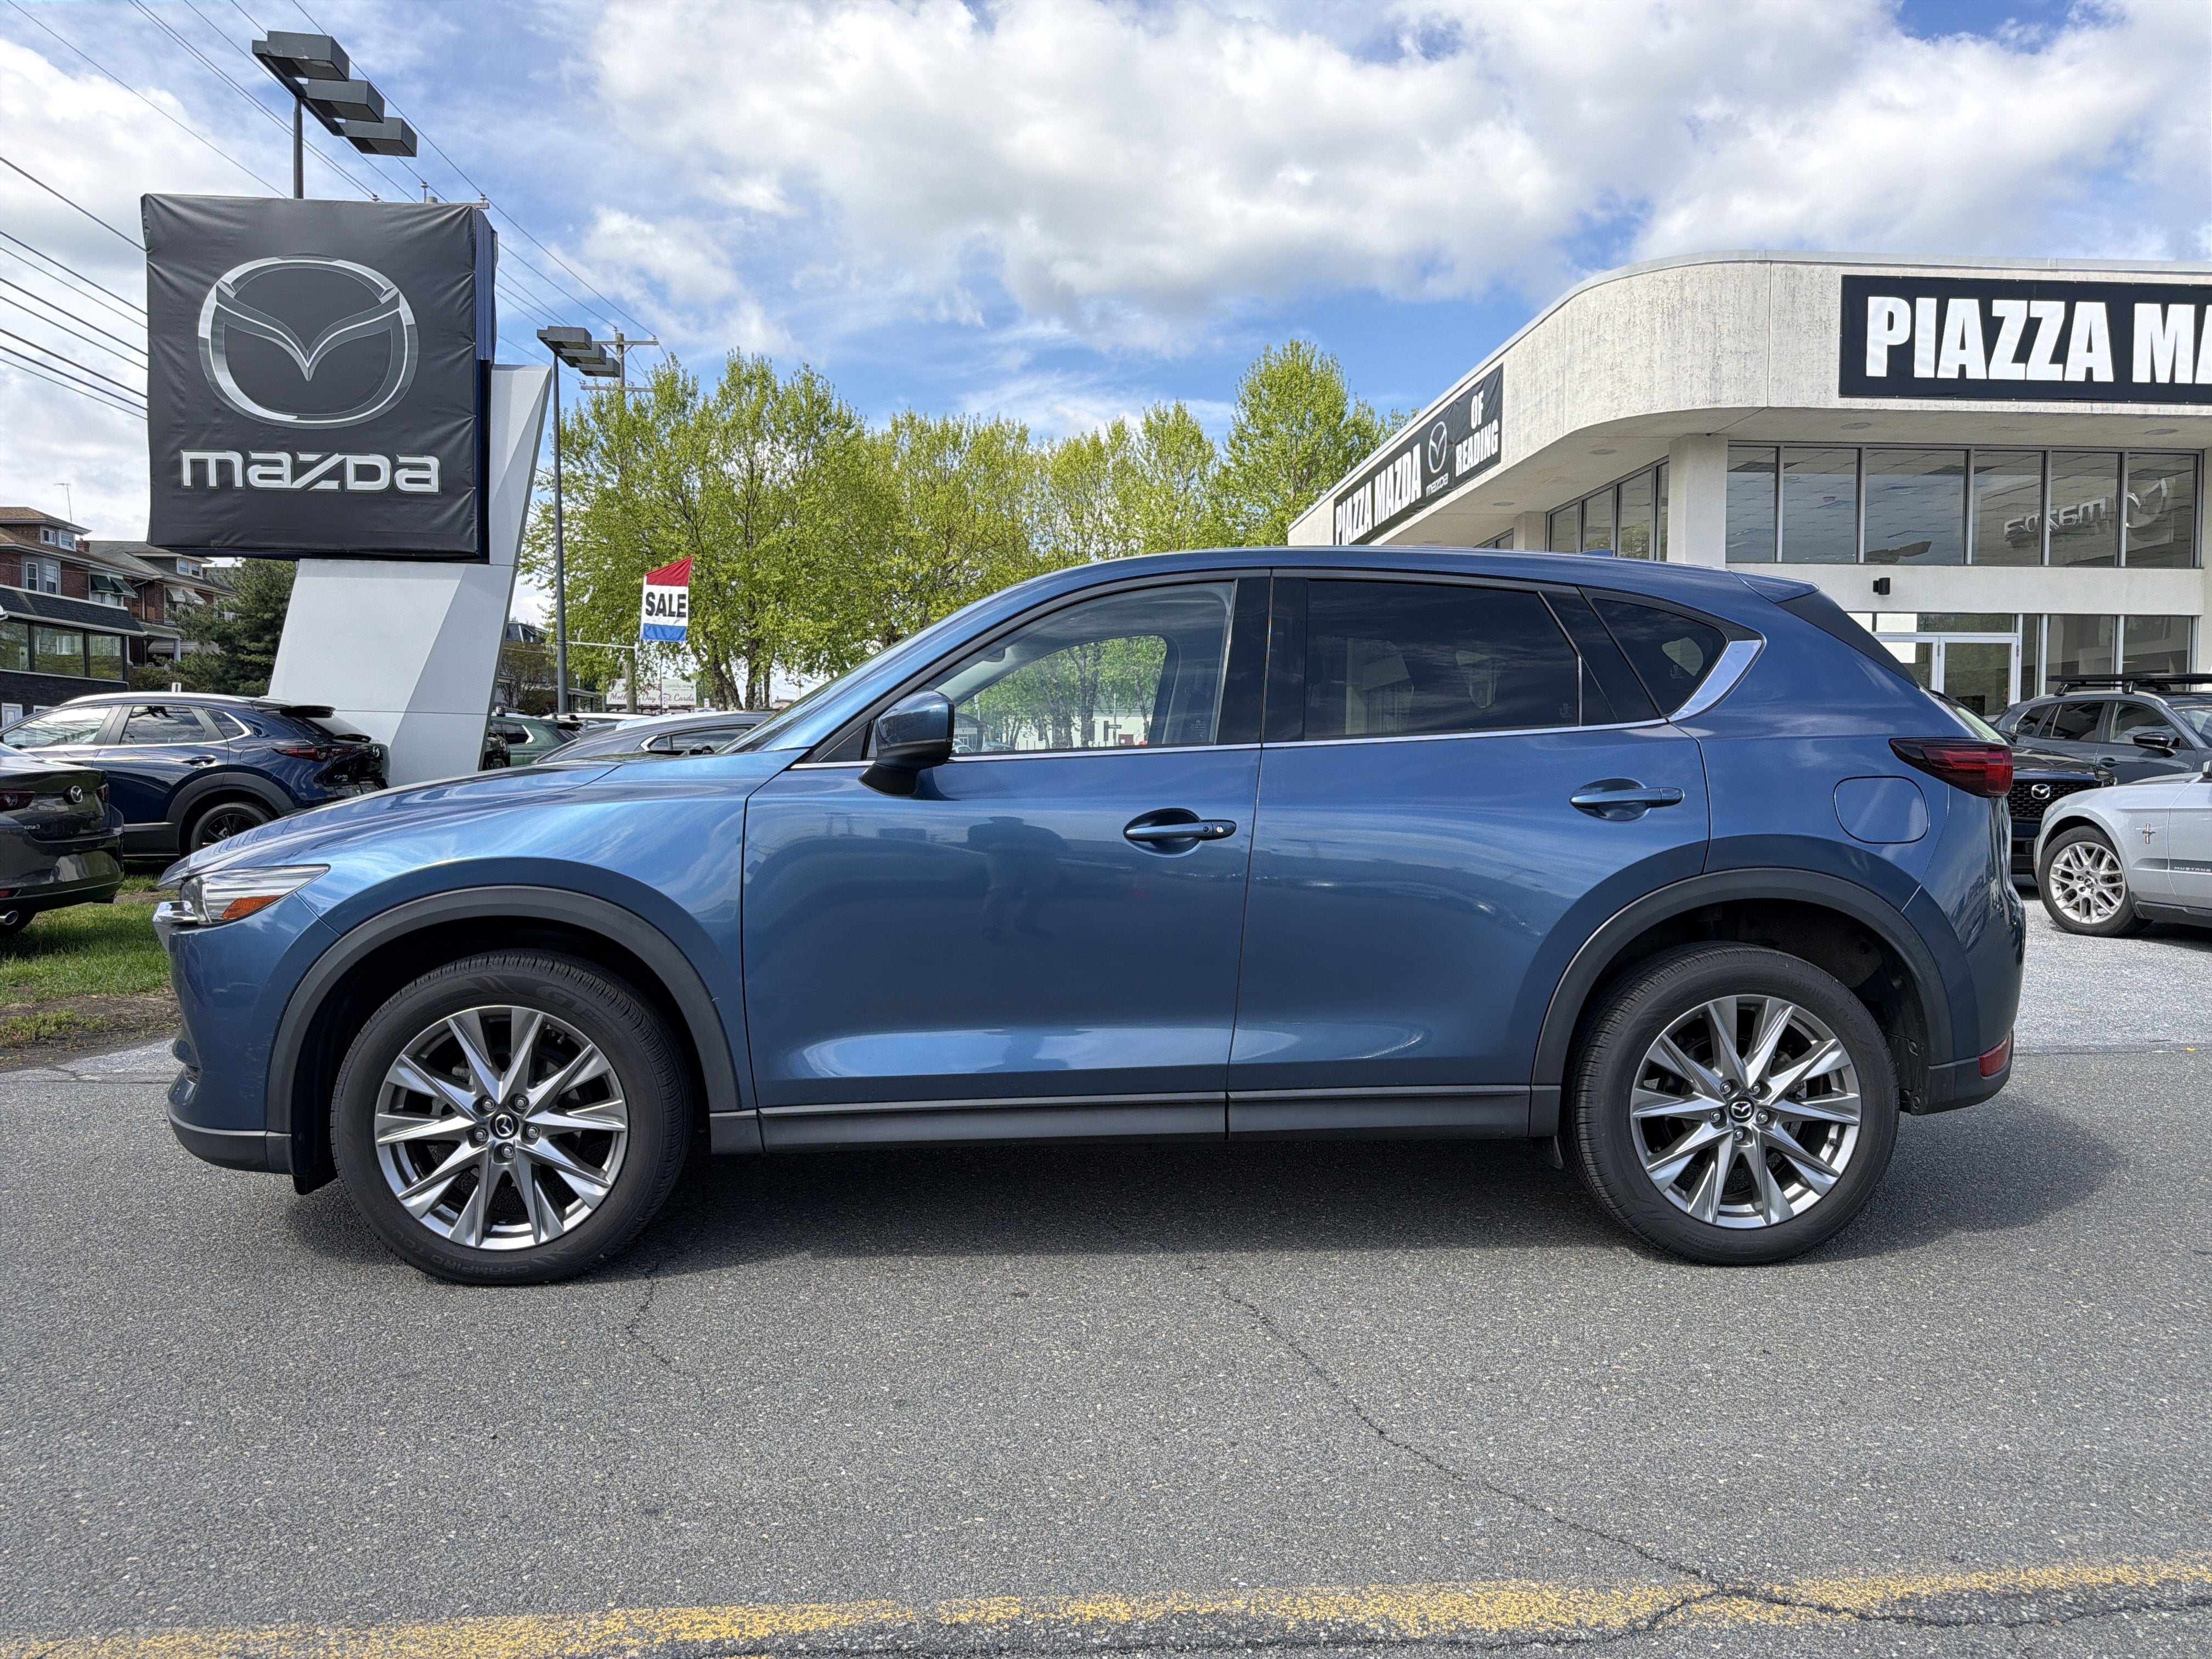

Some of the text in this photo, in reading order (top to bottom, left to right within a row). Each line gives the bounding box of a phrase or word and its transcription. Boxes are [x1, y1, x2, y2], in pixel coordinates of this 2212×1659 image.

[1866, 296, 2114, 382] PIAZZA
[1471, 391, 1483, 429] OF
[1455, 419, 1498, 477] READING
[180, 449, 441, 494] mazda
[1426, 472, 1448, 497] mazda
[1336, 443, 1421, 545] PIAZZA MAZDA
[645, 591, 686, 618] SALE
[642, 693, 656, 702] Day
[432, 1254, 530, 1276] CHAMPIRO
